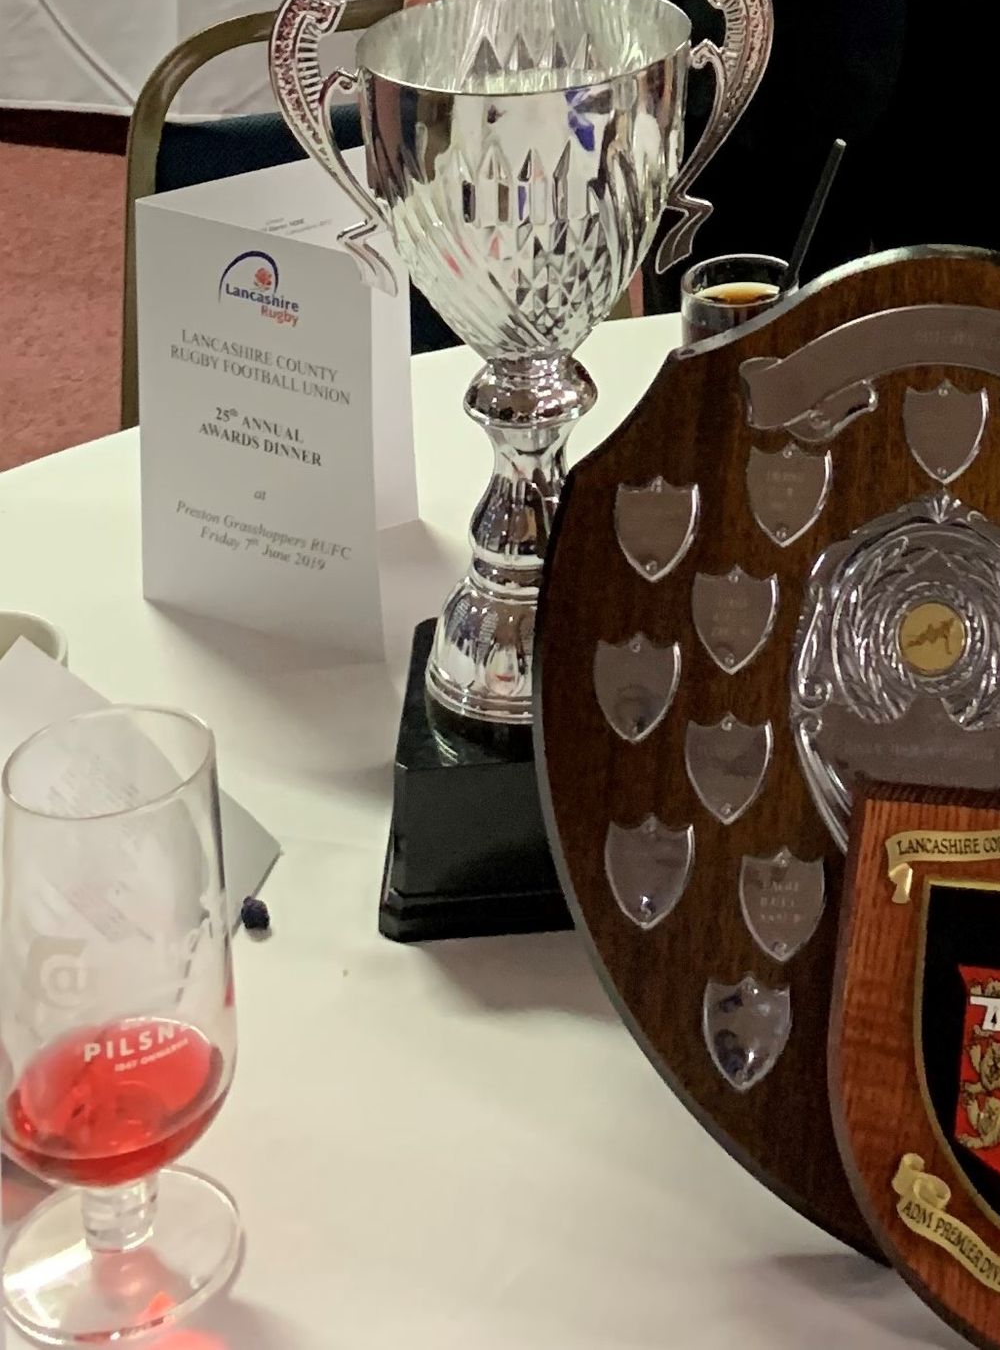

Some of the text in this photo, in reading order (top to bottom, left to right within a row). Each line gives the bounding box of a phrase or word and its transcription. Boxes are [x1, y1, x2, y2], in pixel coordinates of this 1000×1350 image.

[225, 283, 299, 312] Lancashire
[260, 305, 299, 327] Rugby
[170, 345, 351, 405] RUGBY FOOTBALL UNION
[181, 329, 338, 382] LANCASHIRE COUNTY
[199, 422, 322, 467] AWARDS DINNER
[242, 416, 304, 444] ANNUAL
[254, 490, 266, 501] at
[176, 500, 352, 561] Preston Grasshoppers RUFC
[200, 525, 240, 551] Friday
[262, 544, 291, 563] June
[294, 552, 327, 571] 2019
[897, 838, 981, 856] LANCASHIRE
[932, 1216, 984, 1268] PREMIER
